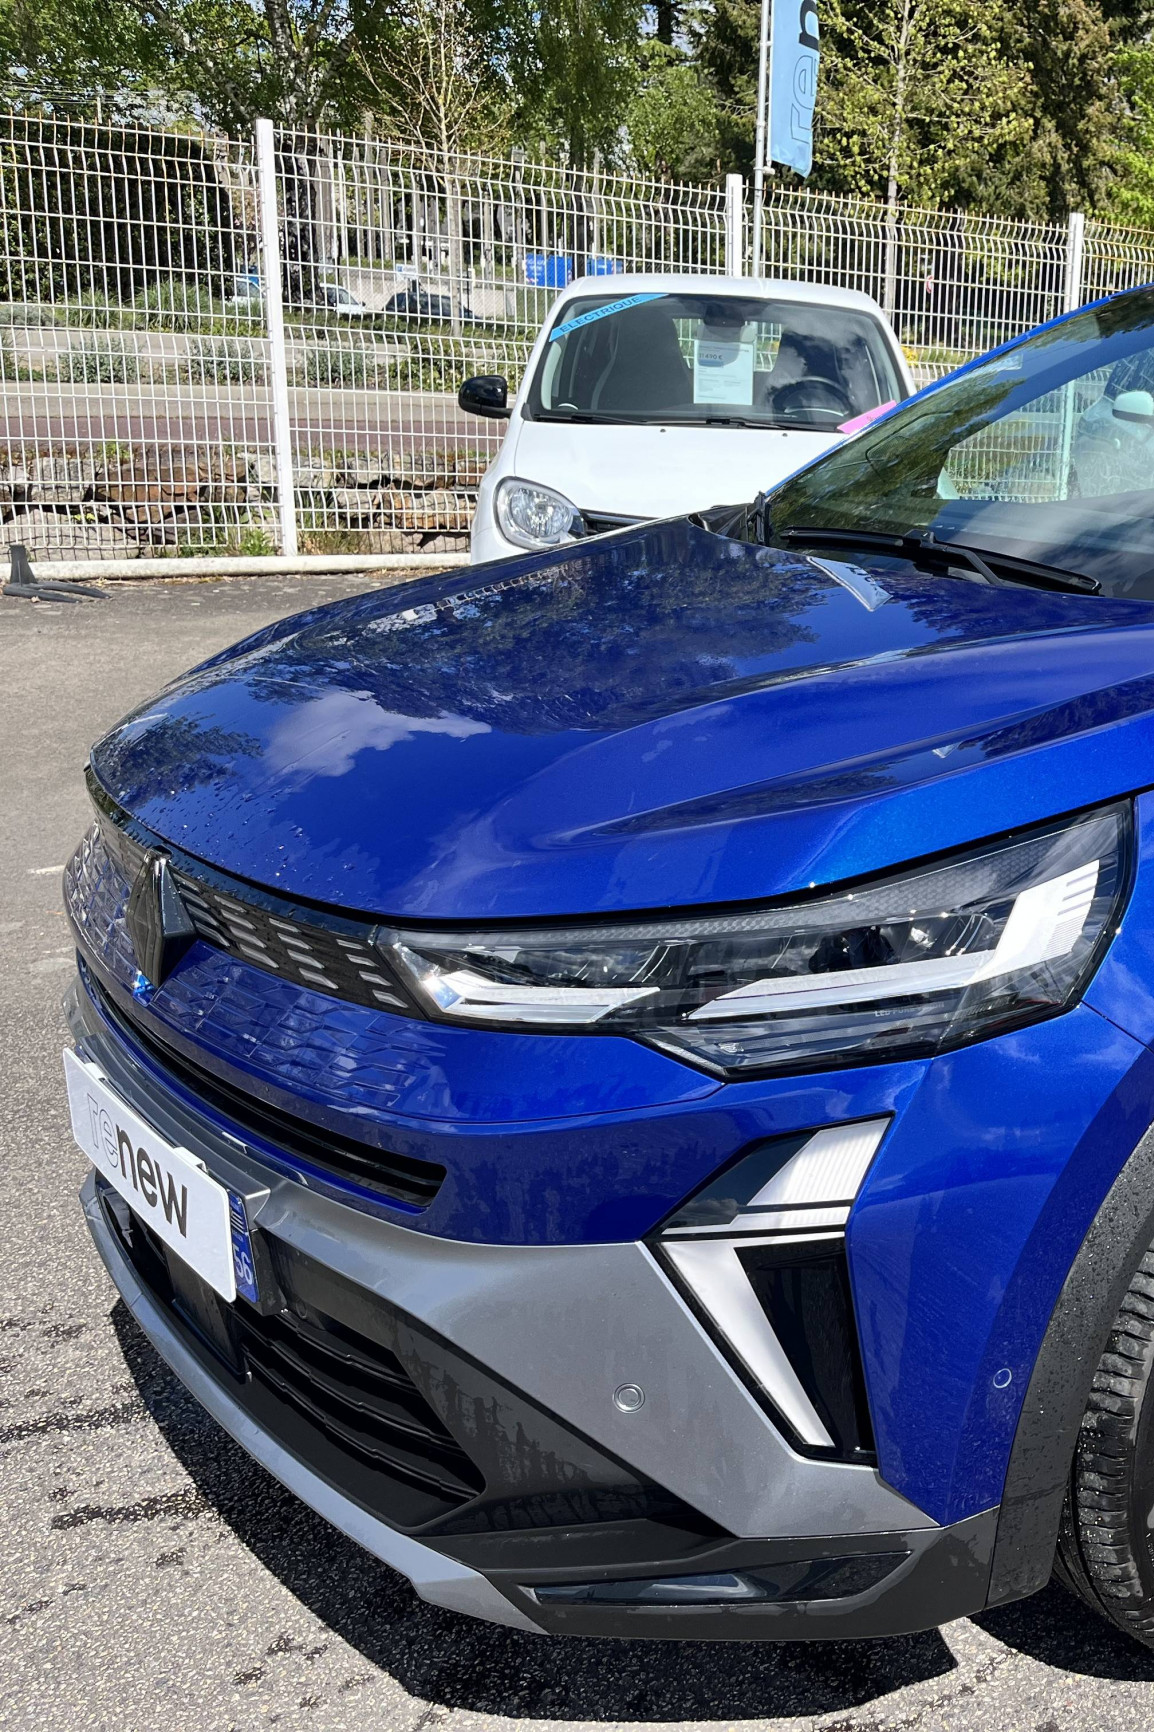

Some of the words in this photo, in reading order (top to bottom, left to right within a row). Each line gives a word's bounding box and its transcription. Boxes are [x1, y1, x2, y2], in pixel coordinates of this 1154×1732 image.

[559, 297, 641, 333] ELECTRIQUE
[86, 1093, 188, 1238] renew
[232, 1244, 253, 1285] 56
